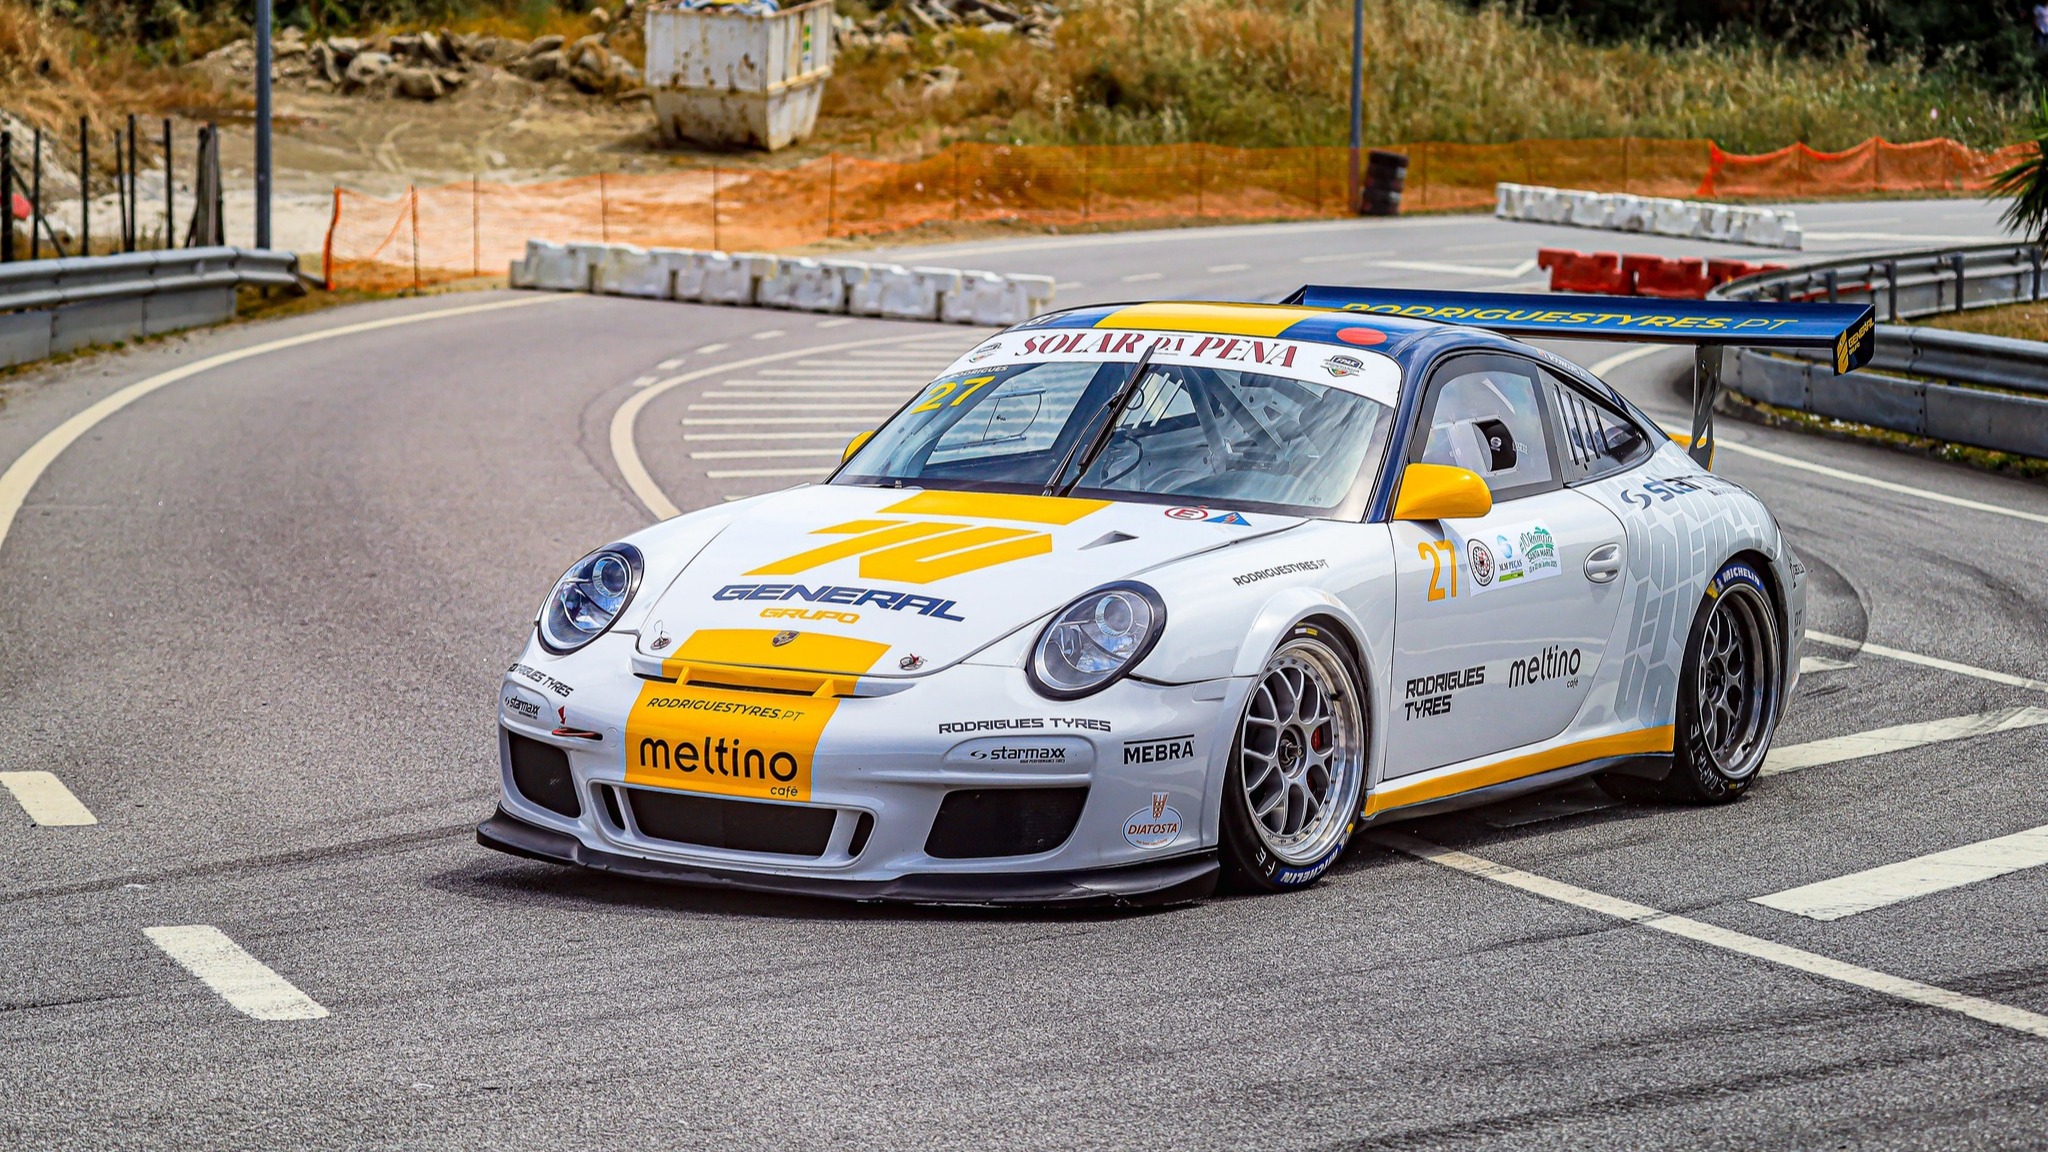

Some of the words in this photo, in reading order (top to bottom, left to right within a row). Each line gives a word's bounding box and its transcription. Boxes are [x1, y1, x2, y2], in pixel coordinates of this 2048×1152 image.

[1342, 303, 1797, 331] RODRIGUESTYRES.PT
[1015, 333, 1145, 356] SOLAR
[1190, 336, 1298, 368] PENA
[910, 375, 996, 415] 27
[1232, 558, 1330, 587] RODRIGUESTYRES.PT
[1418, 539, 1457, 602] 27
[1722, 567, 1760, 586] MICHELIN
[712, 584, 965, 623] GENERAL
[759, 607, 861, 625] GRUPO
[1508, 644, 1581, 689] meltino
[541, 676, 575, 698] TYRES
[1405, 665, 1486, 699] RODRIGUES
[1566, 677, 1579, 689] café
[510, 695, 541, 716] starmaxx
[647, 697, 805, 722] RODRIGUESTYRES.PT
[1404, 694, 1453, 721] TYRES
[938, 718, 1044, 735] RODRIGUES
[1049, 718, 1112, 733] TYRES
[640, 736, 798, 782] meltino
[990, 745, 1066, 761] starmaxx
[1123, 740, 1195, 765] MEBRA
[770, 785, 798, 798] café
[1127, 823, 1178, 835] DIATOSTA
[1280, 848, 1339, 884] MICHELIN
